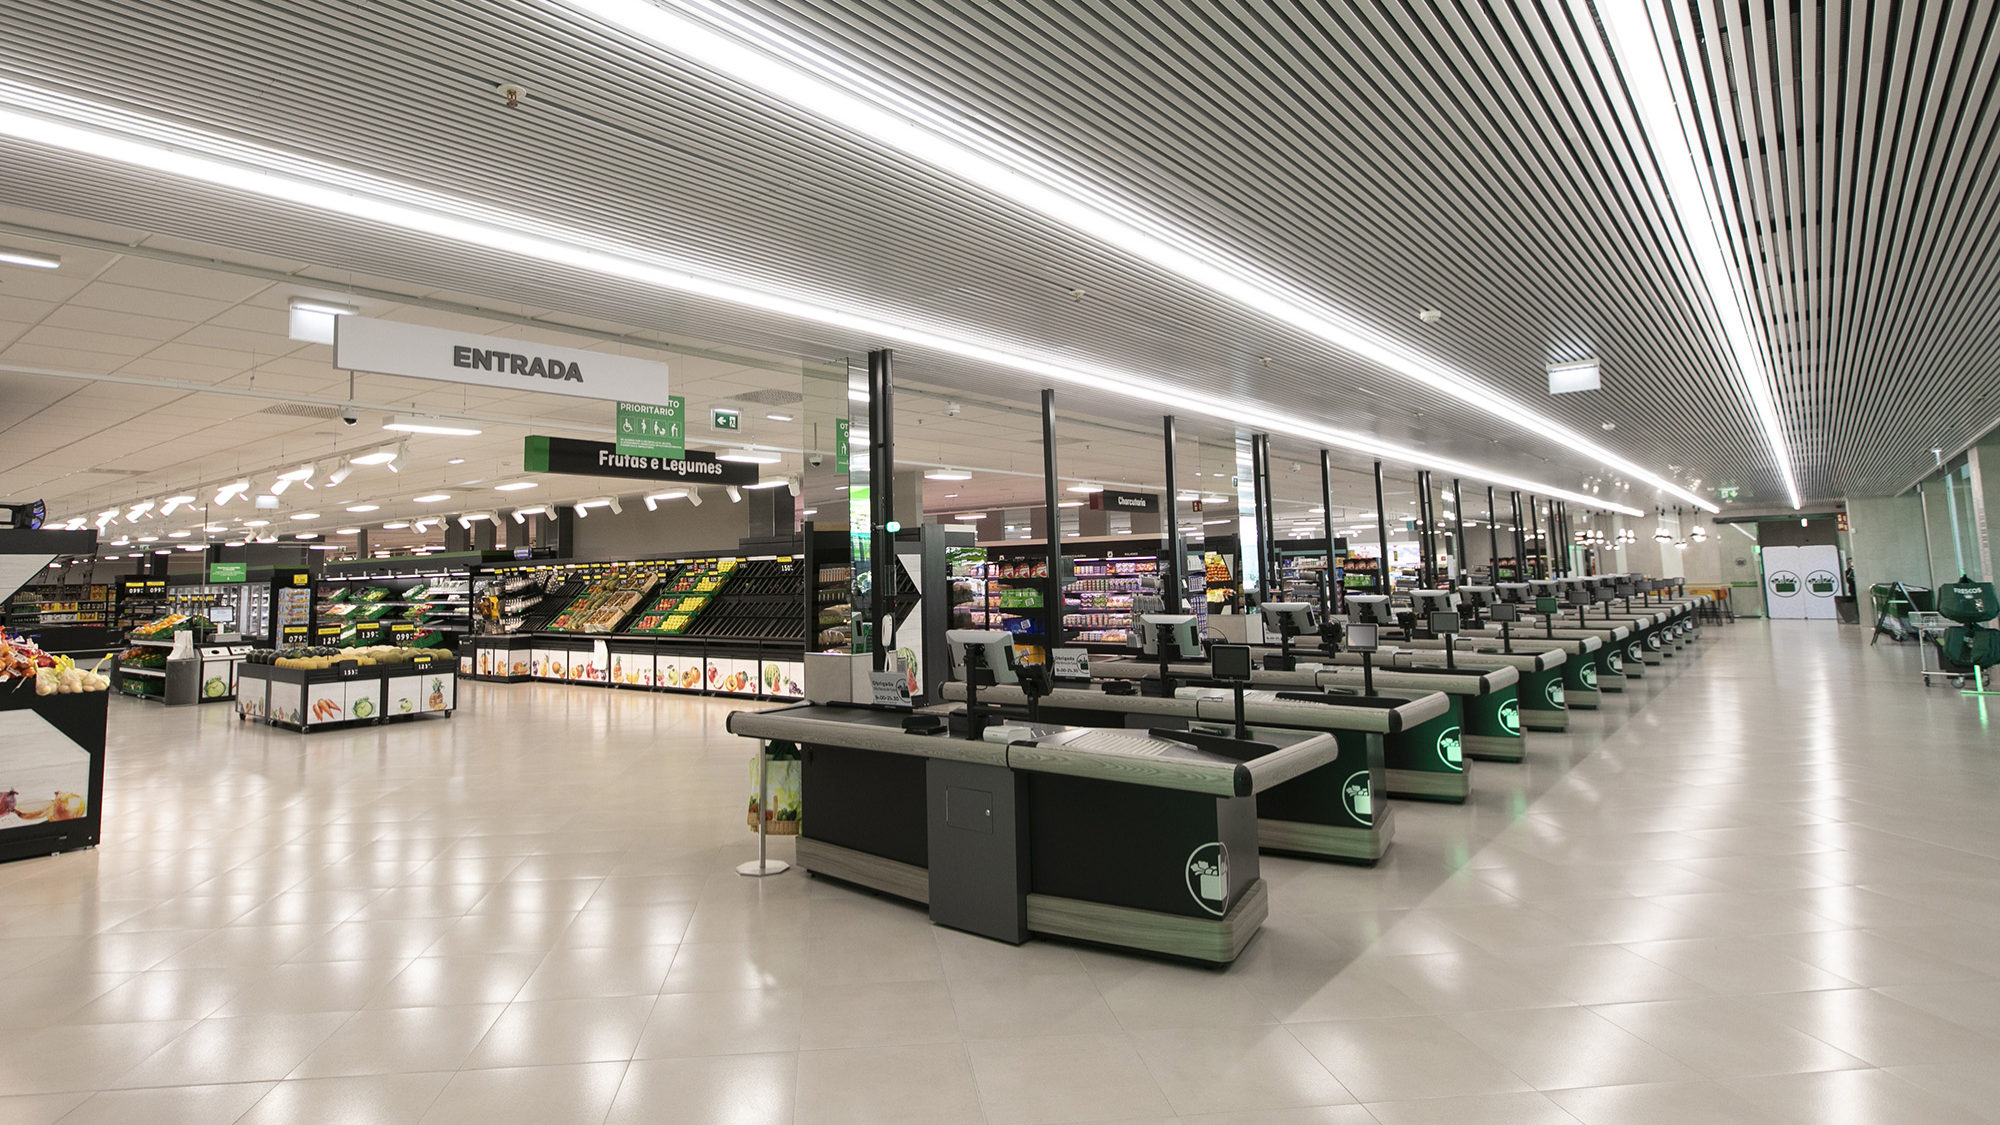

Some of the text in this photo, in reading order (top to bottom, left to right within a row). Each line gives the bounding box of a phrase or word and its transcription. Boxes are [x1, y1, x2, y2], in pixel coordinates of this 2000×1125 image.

[454, 345, 584, 383] ENTRADA
[599, 450, 722, 476] Frutas e Legumes
